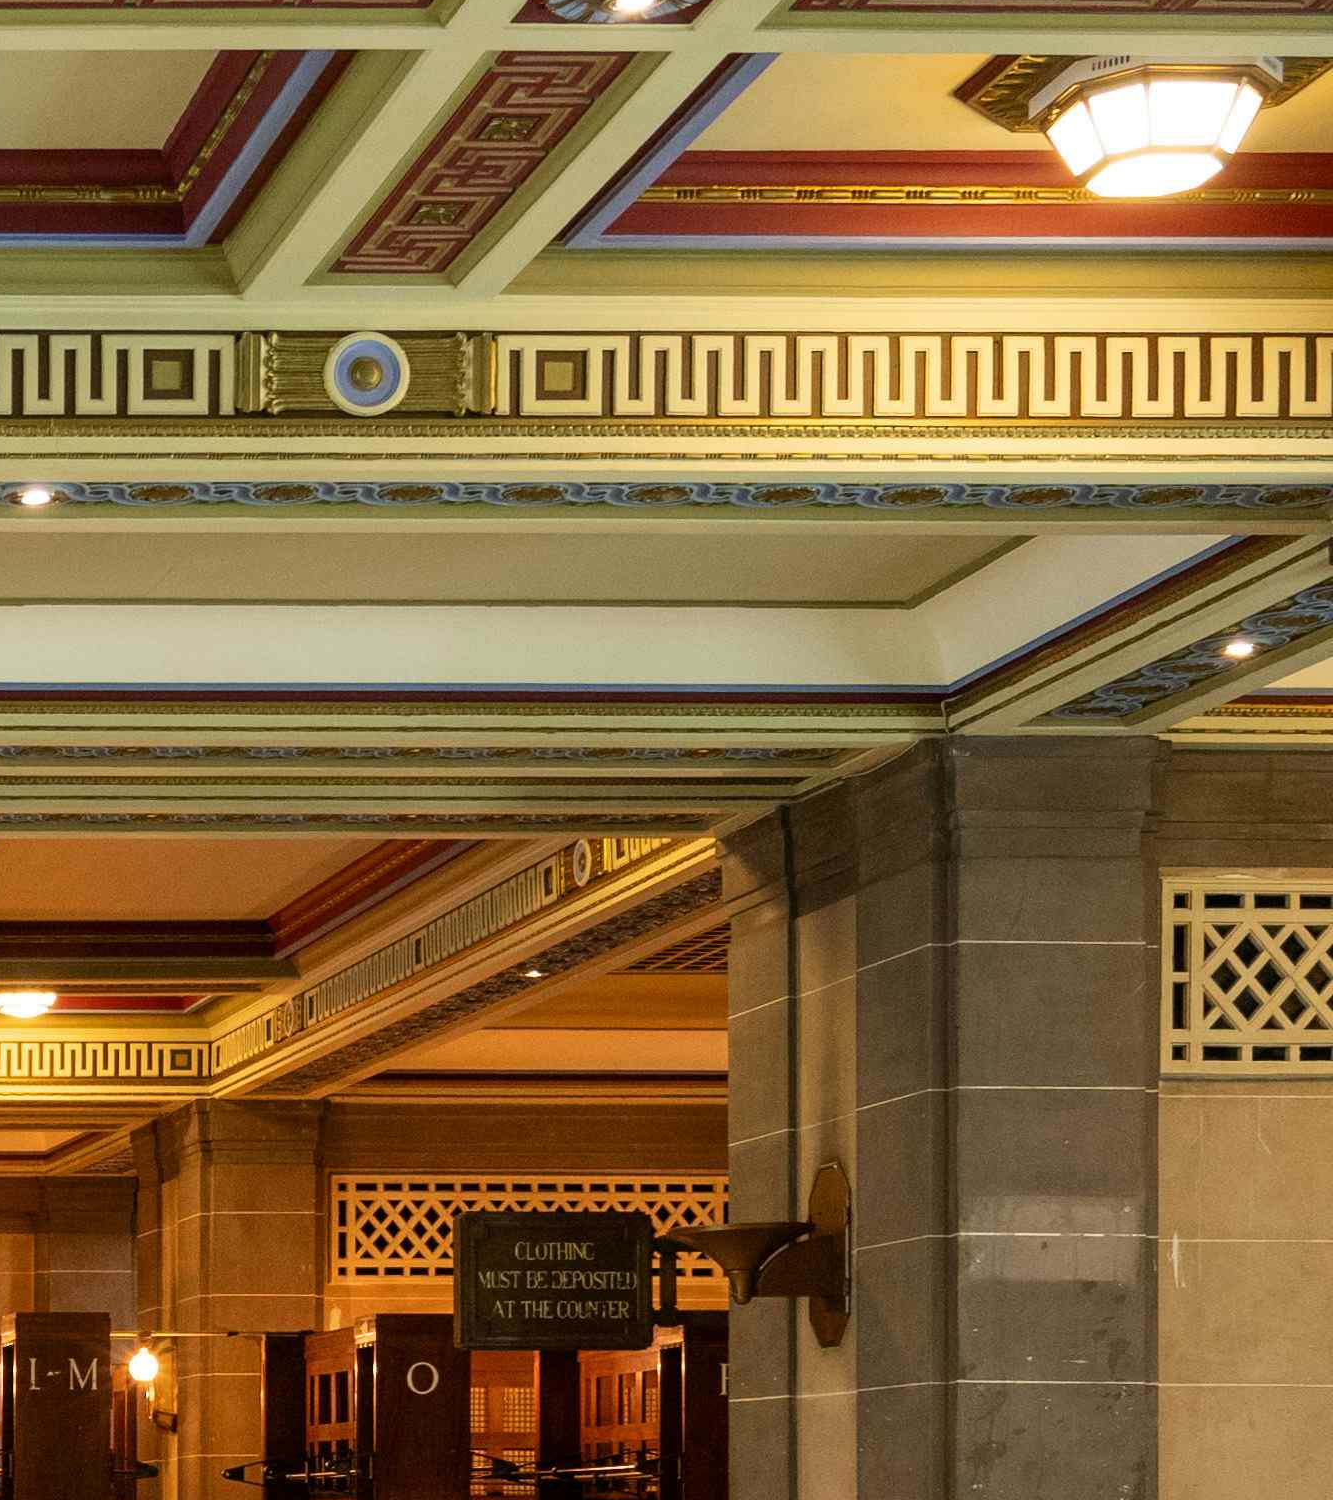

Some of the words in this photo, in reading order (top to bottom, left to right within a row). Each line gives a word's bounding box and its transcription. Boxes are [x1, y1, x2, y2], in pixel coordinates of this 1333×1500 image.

[514, 1241, 595, 1261] CLOTHING
[477, 1270, 522, 1290] MUST
[526, 1270, 549, 1290] BE
[551, 1270, 638, 1290] DEPOSITED
[492, 1300, 516, 1319] AT
[521, 1300, 554, 1320] THE
[556, 1300, 630, 1320] COUNTER
[406, 1361, 439, 1395] O
